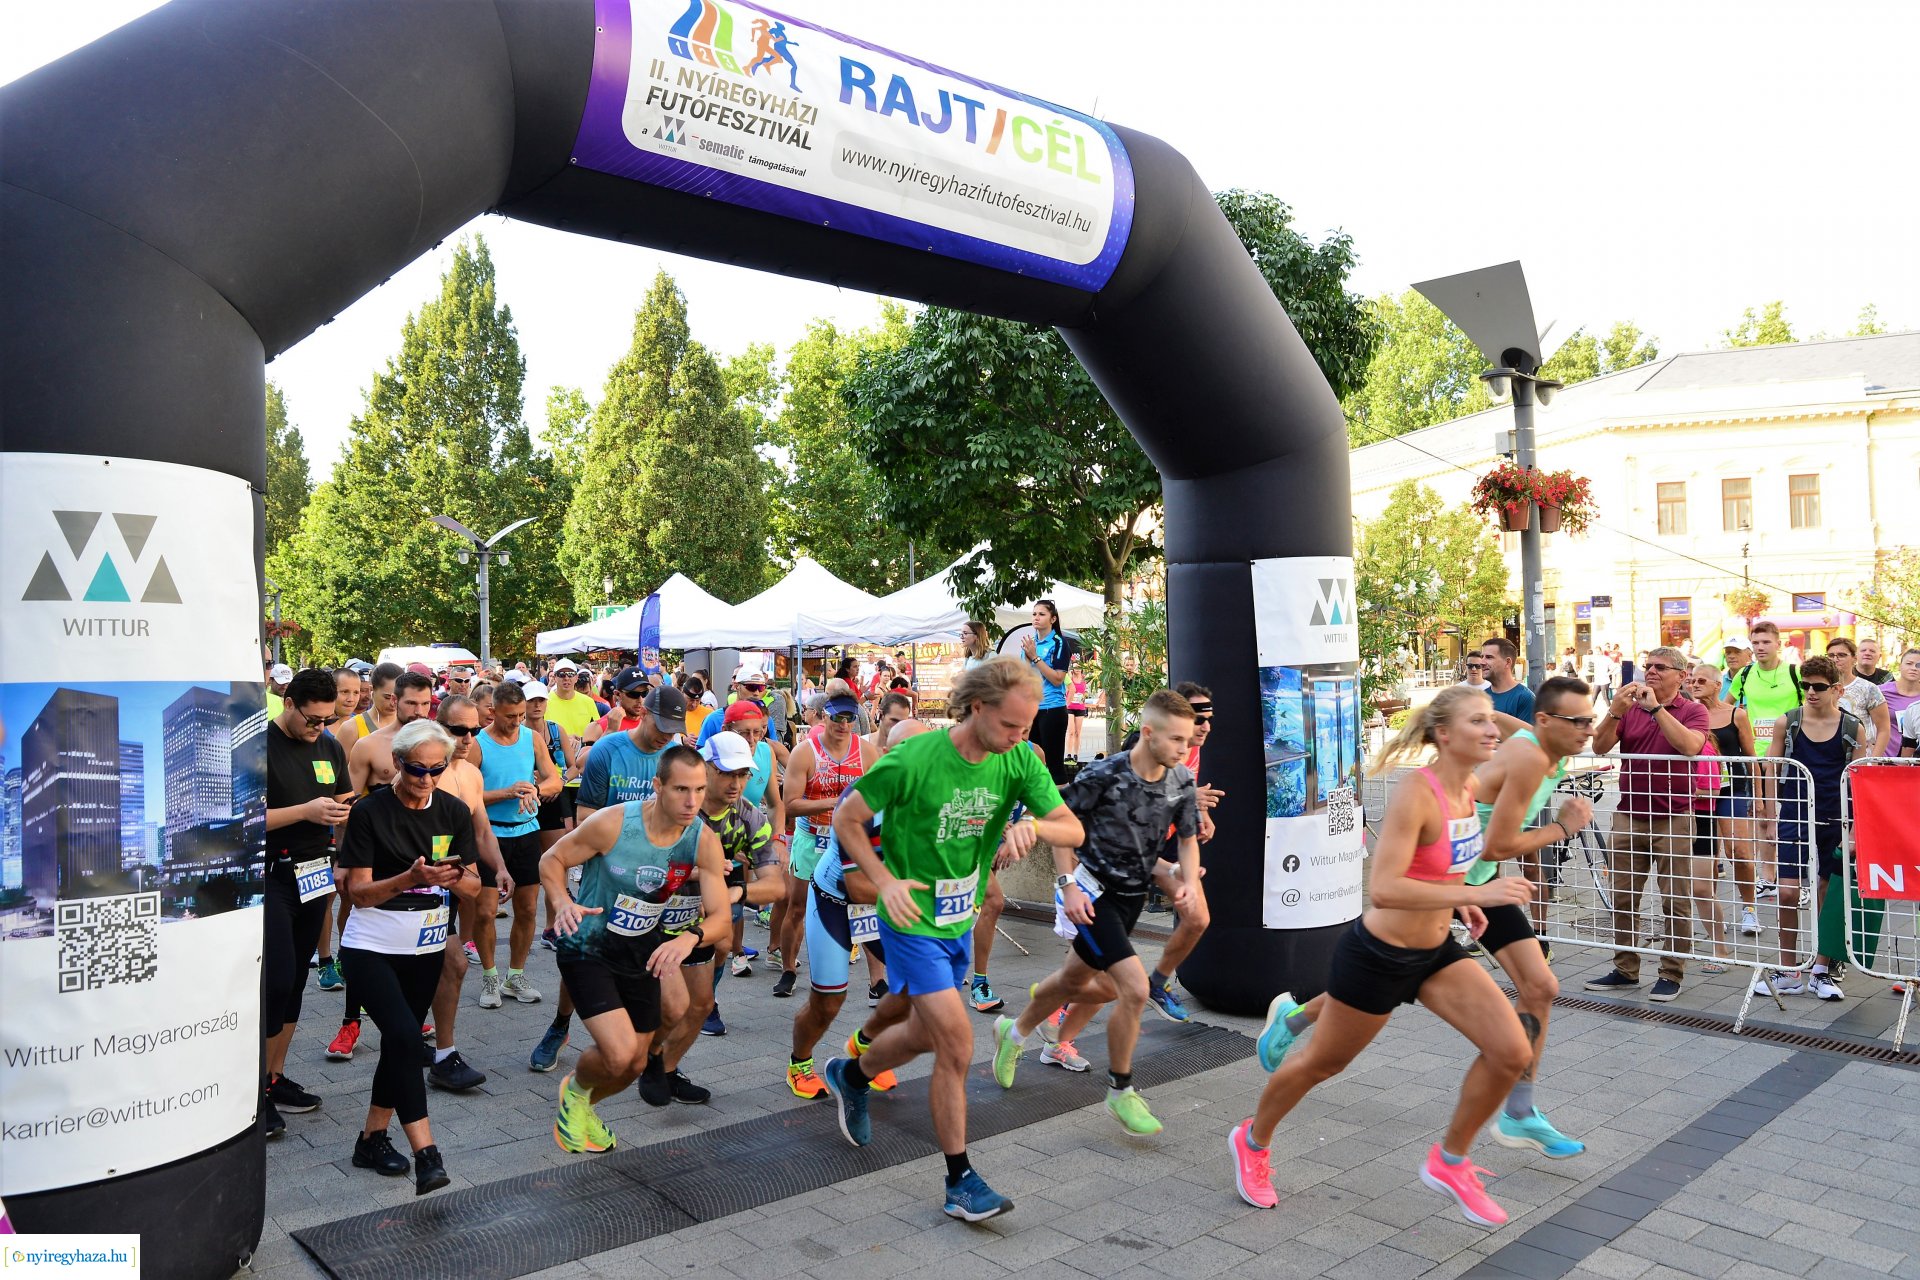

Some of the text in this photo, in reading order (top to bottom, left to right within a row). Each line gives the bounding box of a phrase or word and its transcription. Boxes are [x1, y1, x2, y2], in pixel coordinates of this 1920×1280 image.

[649, 58, 819, 126] II. NYÍREGYHÁZI
[646, 85, 812, 151] FUTÓFESZTIVÁL
[641, 127, 648, 135] a
[698, 138, 745, 161] sematic
[748, 155, 807, 178] támogatásával
[841, 147, 1092, 233] www.nyiregyhazifutofesztival.hu
[62, 617, 150, 637] WITTUR
[617, 791, 651, 801] HUNGA
[1310, 853, 1337, 867] Wittur
[298, 871, 329, 893] 21185
[421, 926, 448, 945] 210
[854, 916, 879, 935] 210
[5, 1010, 239, 1068] Wittur Magyarország
[1, 1082, 220, 1142] karrier@wittur.com
